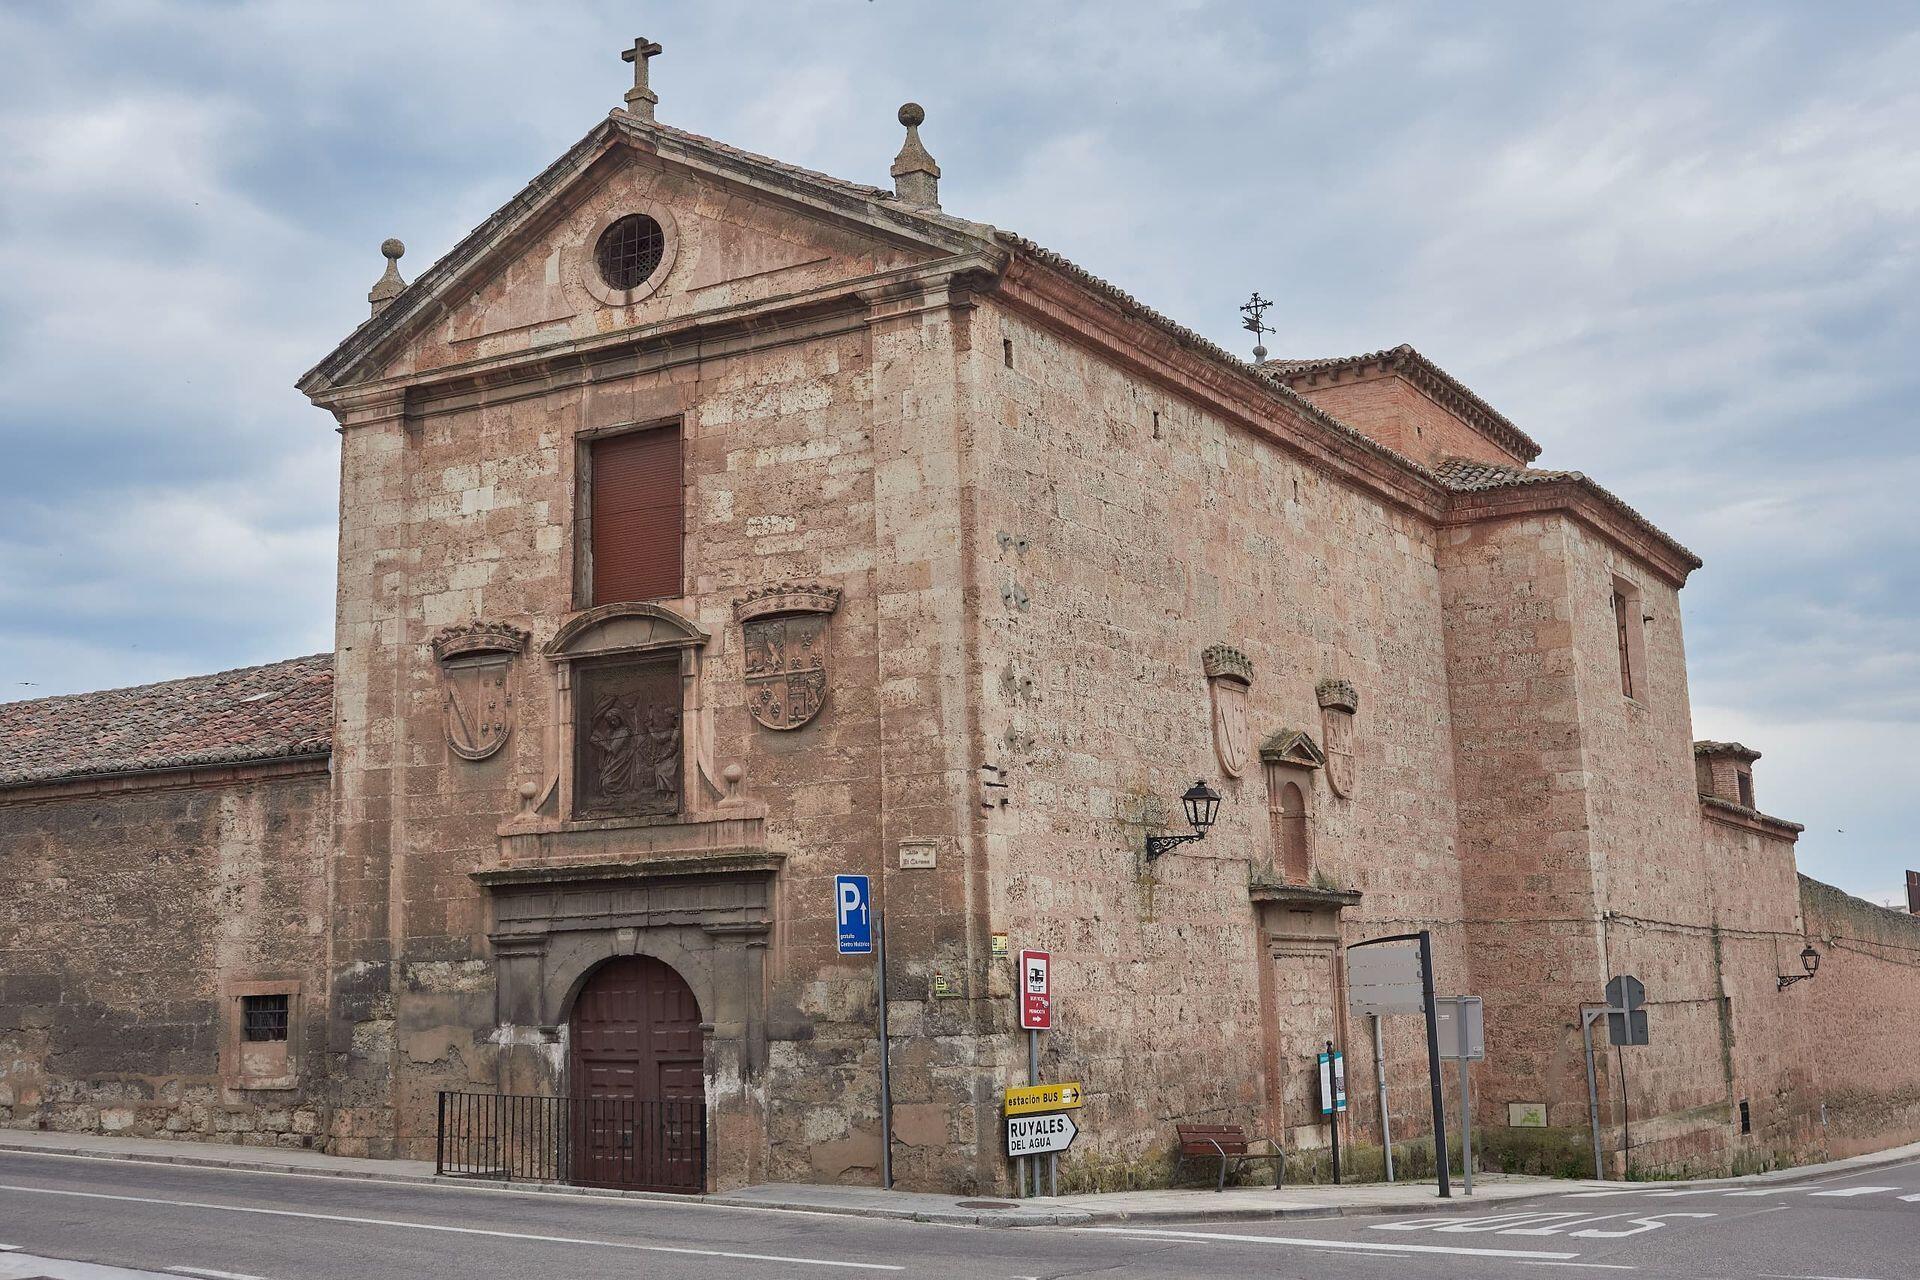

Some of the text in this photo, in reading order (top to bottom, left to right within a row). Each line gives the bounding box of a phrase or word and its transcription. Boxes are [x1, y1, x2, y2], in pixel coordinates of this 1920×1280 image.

[840, 883, 860, 925] P
[1008, 1092, 1058, 1106] estación BUS
[1010, 1118, 1064, 1138] RUYALES
[1011, 1137, 1051, 1151] DEL AGUA
